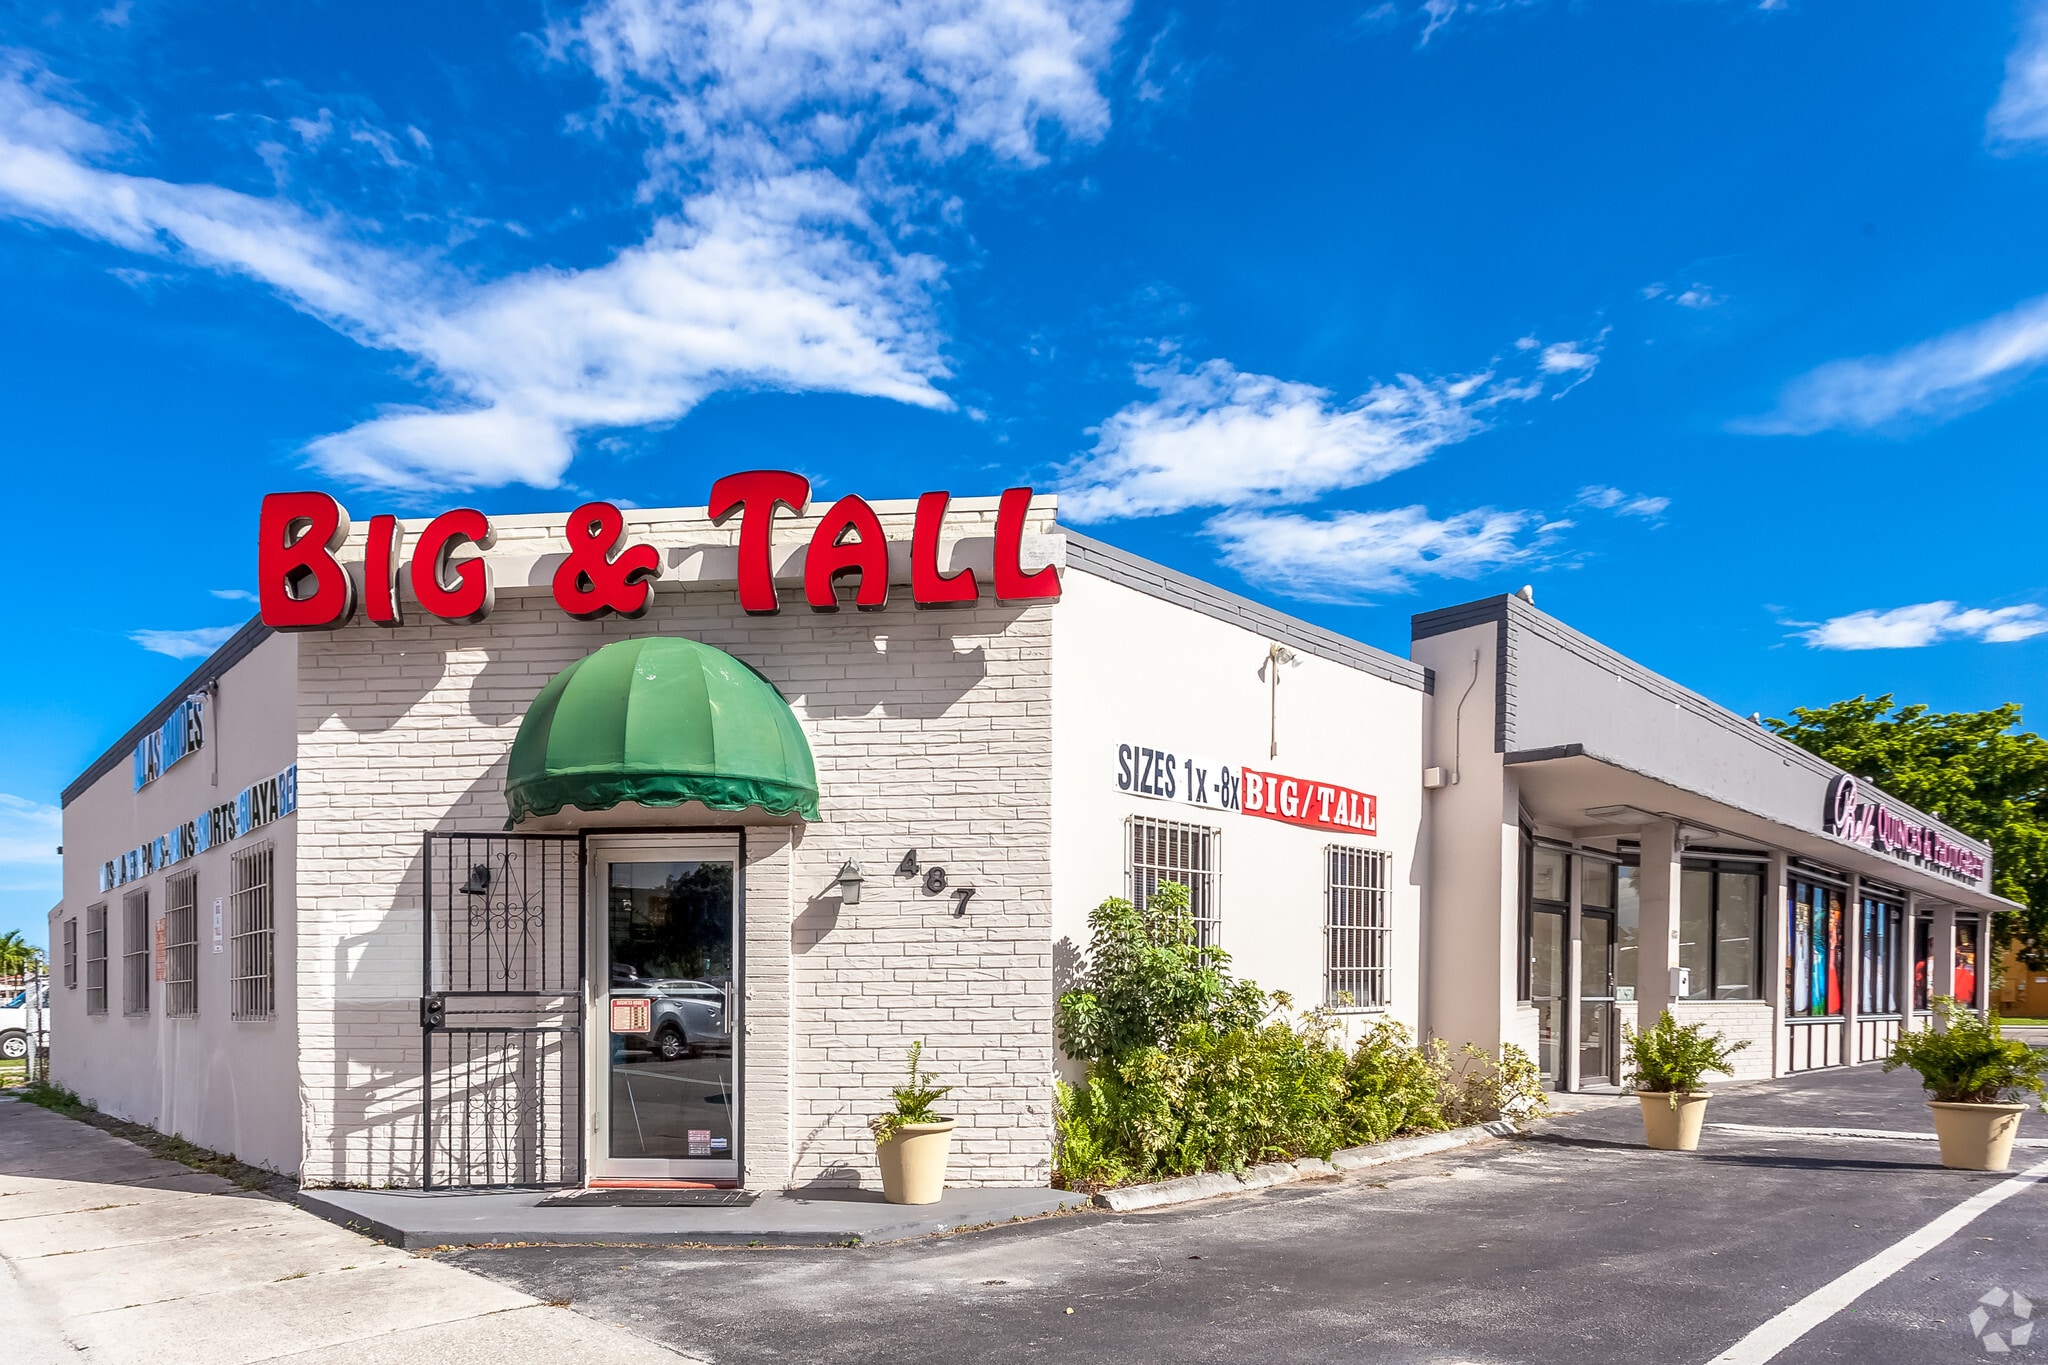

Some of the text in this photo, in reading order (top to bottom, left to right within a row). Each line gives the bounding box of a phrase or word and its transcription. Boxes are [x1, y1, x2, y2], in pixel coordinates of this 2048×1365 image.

[260, 468, 1062, 630] BIG & TALL
[1117, 743, 1176, 799] SIZES
[1244, 770, 1376, 832] BIG/TALL
[900, 848, 976, 916] 487
